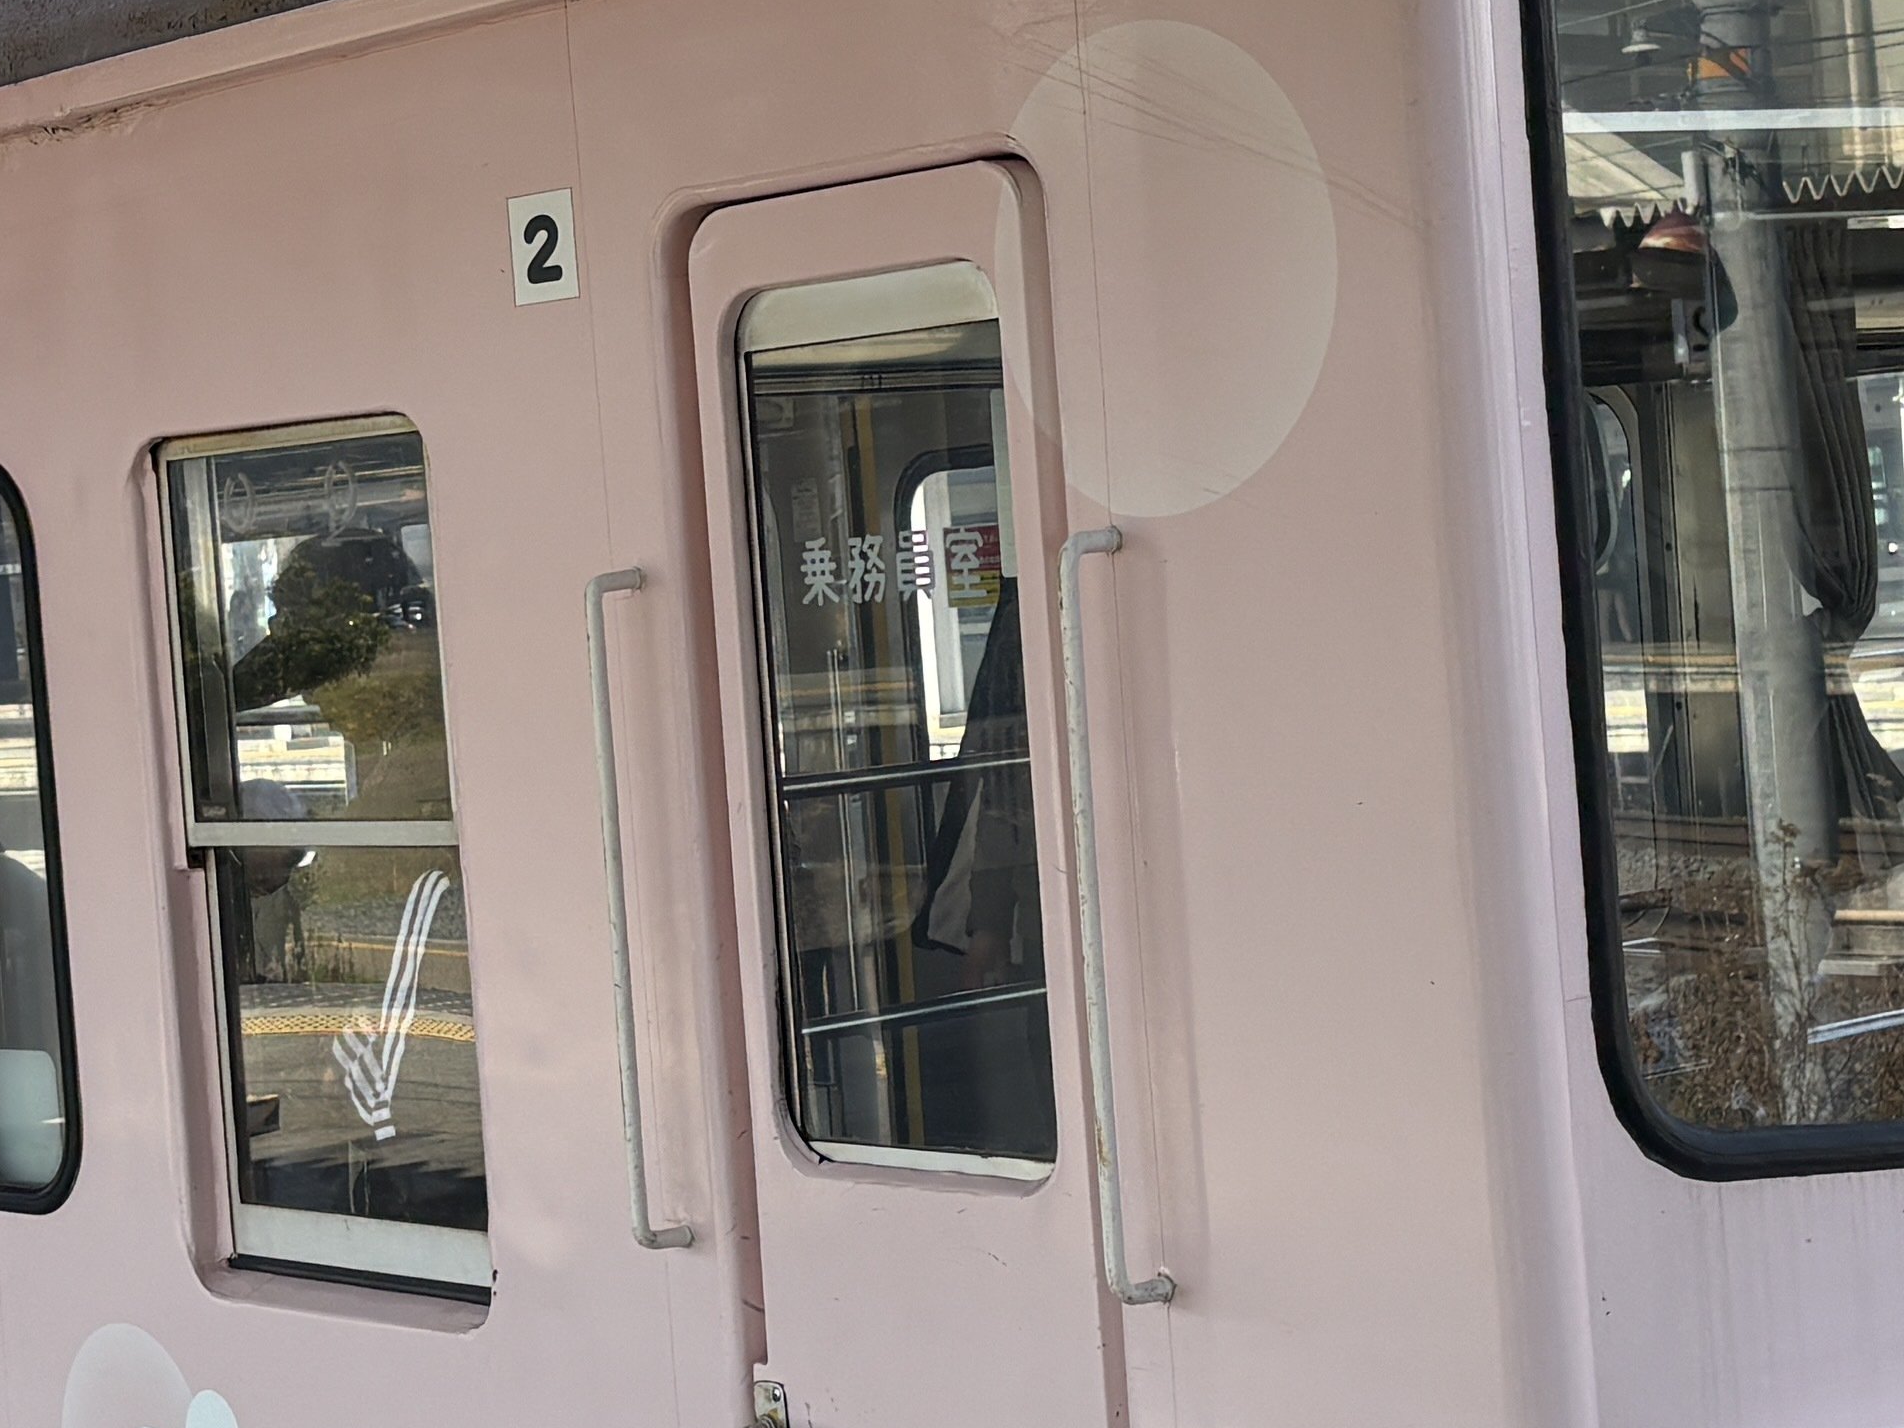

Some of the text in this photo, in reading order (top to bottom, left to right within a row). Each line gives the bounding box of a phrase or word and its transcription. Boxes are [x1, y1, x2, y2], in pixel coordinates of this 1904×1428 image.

[523, 214, 563, 284] 2
[800, 527, 988, 606] 乗務員室
